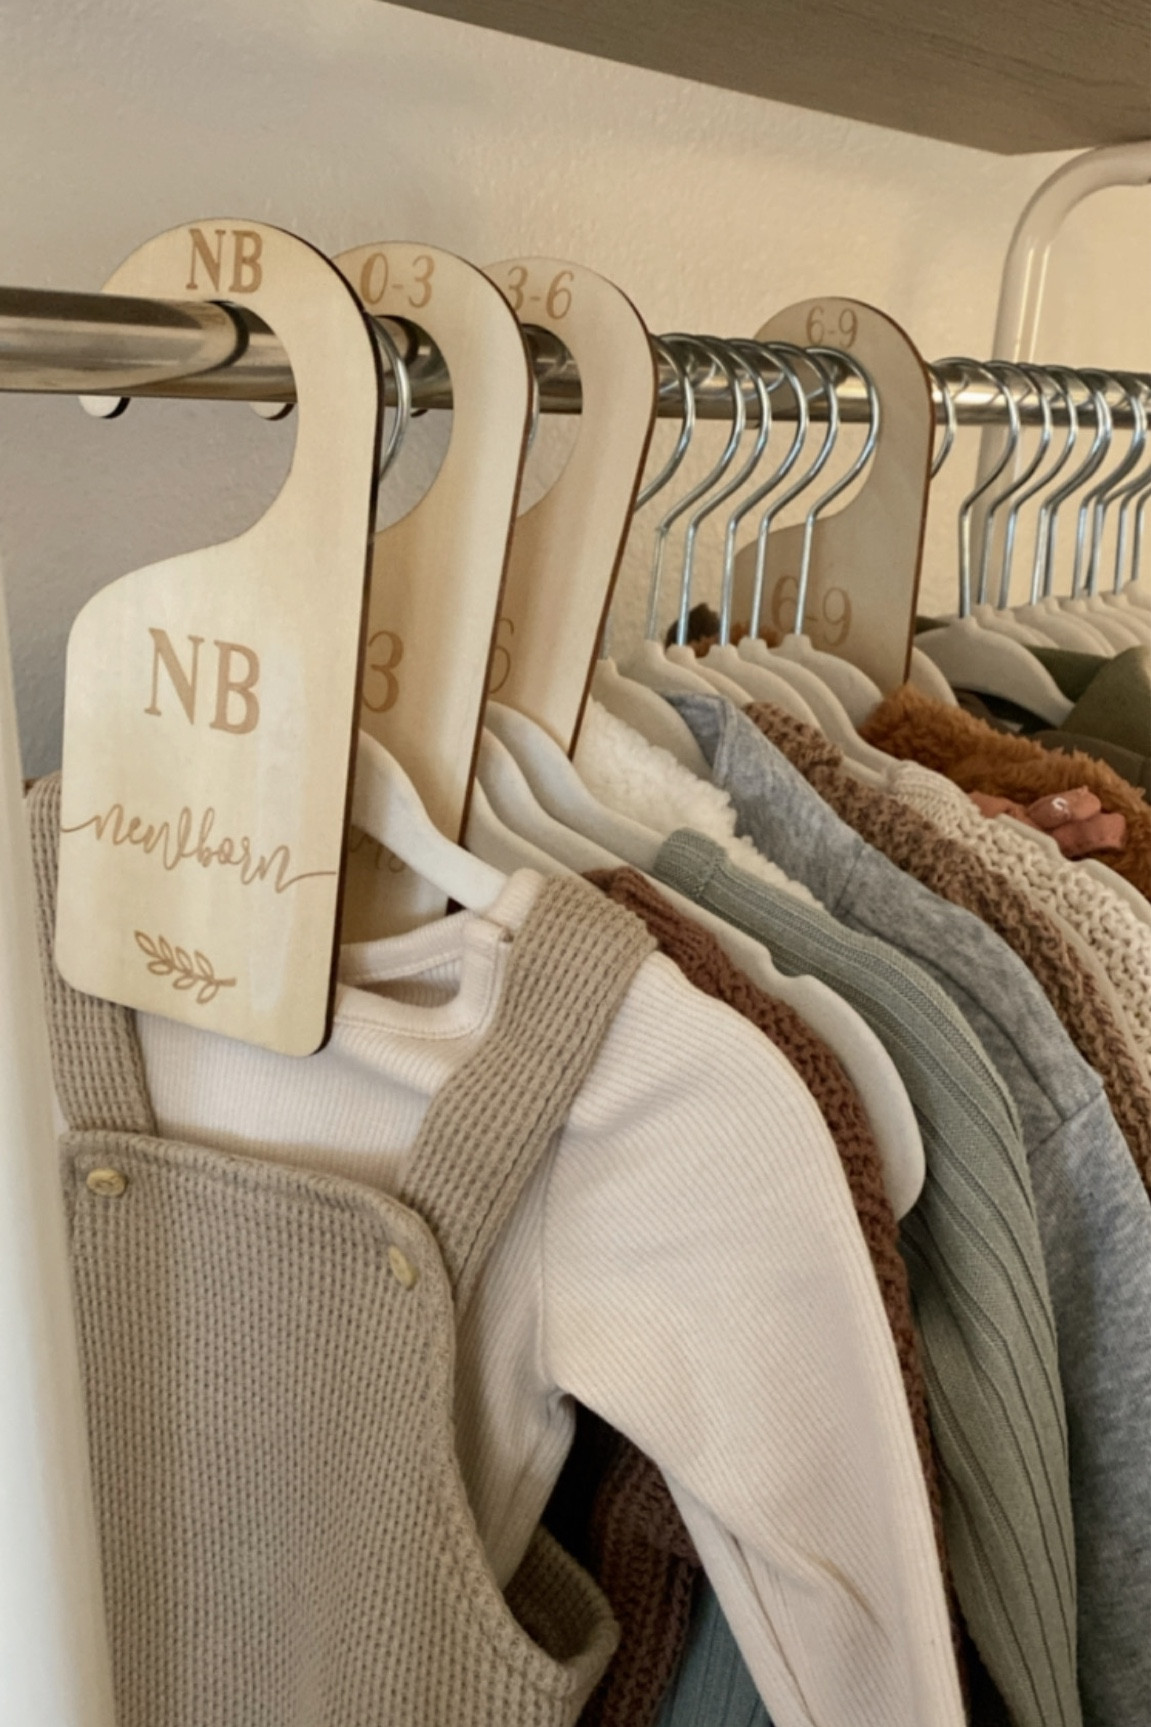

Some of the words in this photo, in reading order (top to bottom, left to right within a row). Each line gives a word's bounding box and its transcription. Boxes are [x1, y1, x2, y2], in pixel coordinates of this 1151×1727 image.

[186, 227, 263, 294] NB
[360, 251, 435, 309] 0-3
[507, 265, 575, 320] 3-6
[806, 305, 858, 350] 6-9
[771, 575, 852, 647] 6-9
[144, 627, 260, 735] NB
[61, 803, 337, 893] newborn
